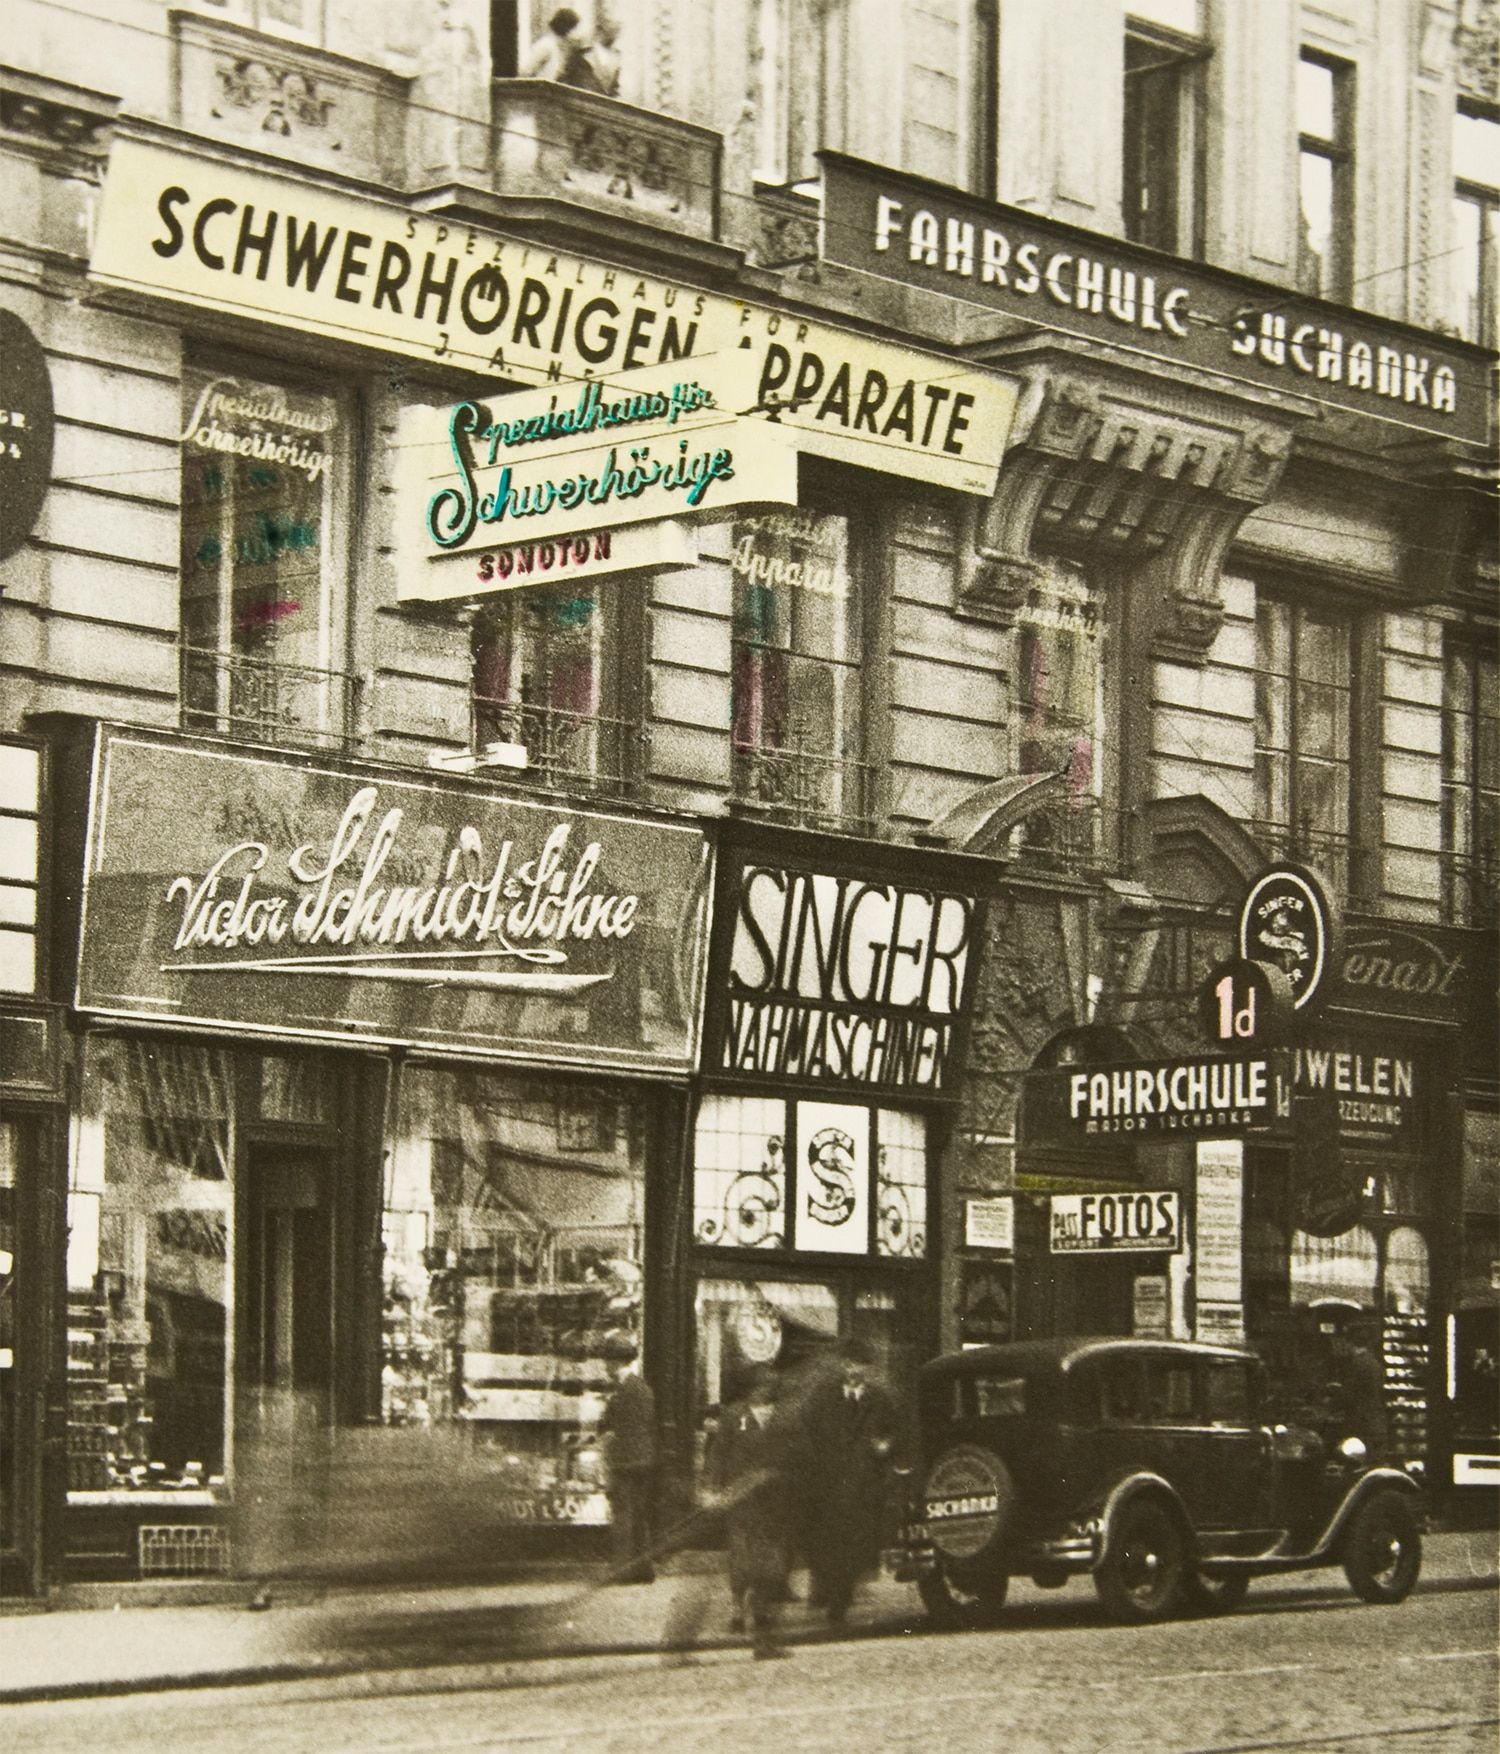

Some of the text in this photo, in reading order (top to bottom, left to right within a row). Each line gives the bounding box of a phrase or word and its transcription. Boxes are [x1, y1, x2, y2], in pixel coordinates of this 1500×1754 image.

[405, 215, 706, 317] SPEZIALHAUS
[875, 195, 1456, 413] FAHRSCHULE SUCHANKA
[151, 185, 976, 455] SCHWERHÖRIGEN PPARATE
[450, 381, 667, 466] Spezialhaus
[426, 439, 736, 546] Schwerhörige
[476, 531, 612, 585] SONOTON
[166, 841, 290, 951] Victor
[288, 786, 512, 946] Schmidt
[505, 822, 640, 944] Söhne
[730, 866, 976, 1014] SINGER
[1215, 976, 1256, 1039] 1d
[1070, 1060, 1267, 1119] FAHRSCHULE
[1080, 1193, 1174, 1239] FOTOS
